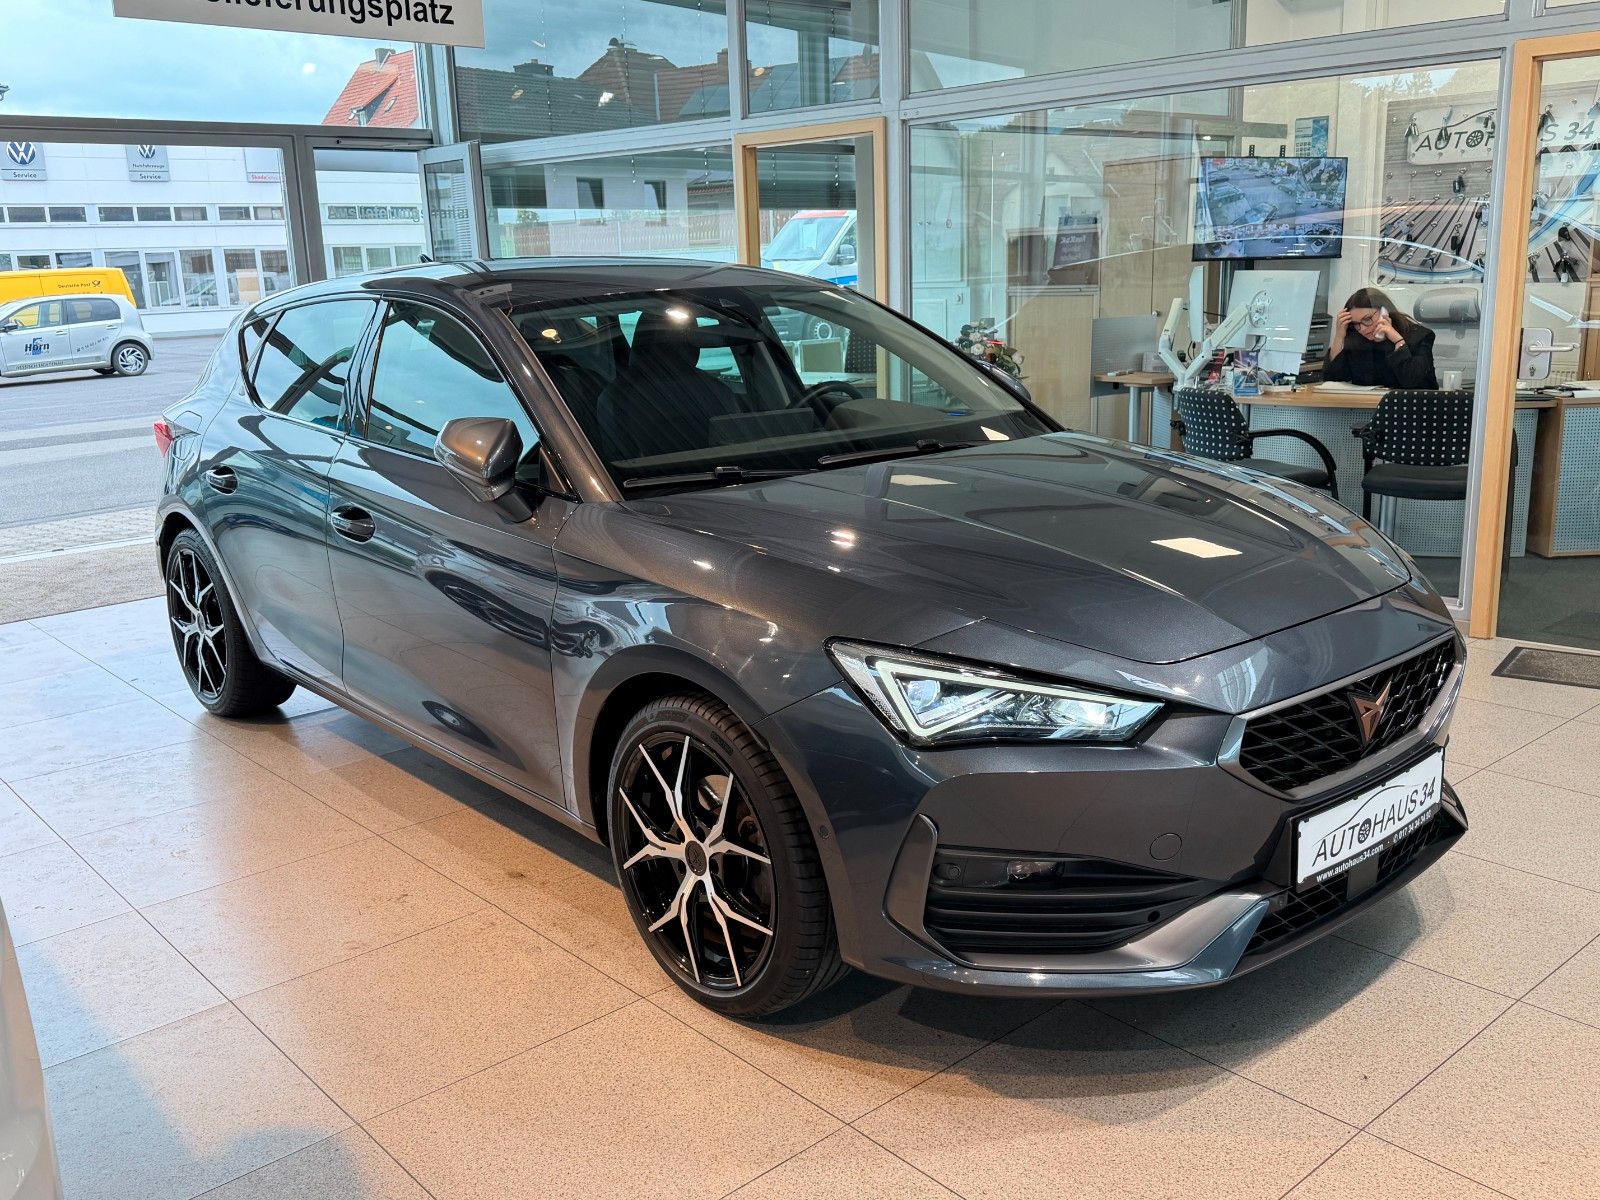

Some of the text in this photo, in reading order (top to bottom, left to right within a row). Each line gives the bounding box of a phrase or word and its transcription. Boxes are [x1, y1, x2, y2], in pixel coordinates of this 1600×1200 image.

[1563, 120, 1595, 140] 34
[25, 343, 50, 352] Horn
[1312, 777, 1436, 867] AUTOHAUS 34
[1316, 843, 1384, 882] www.autohaus34.com
